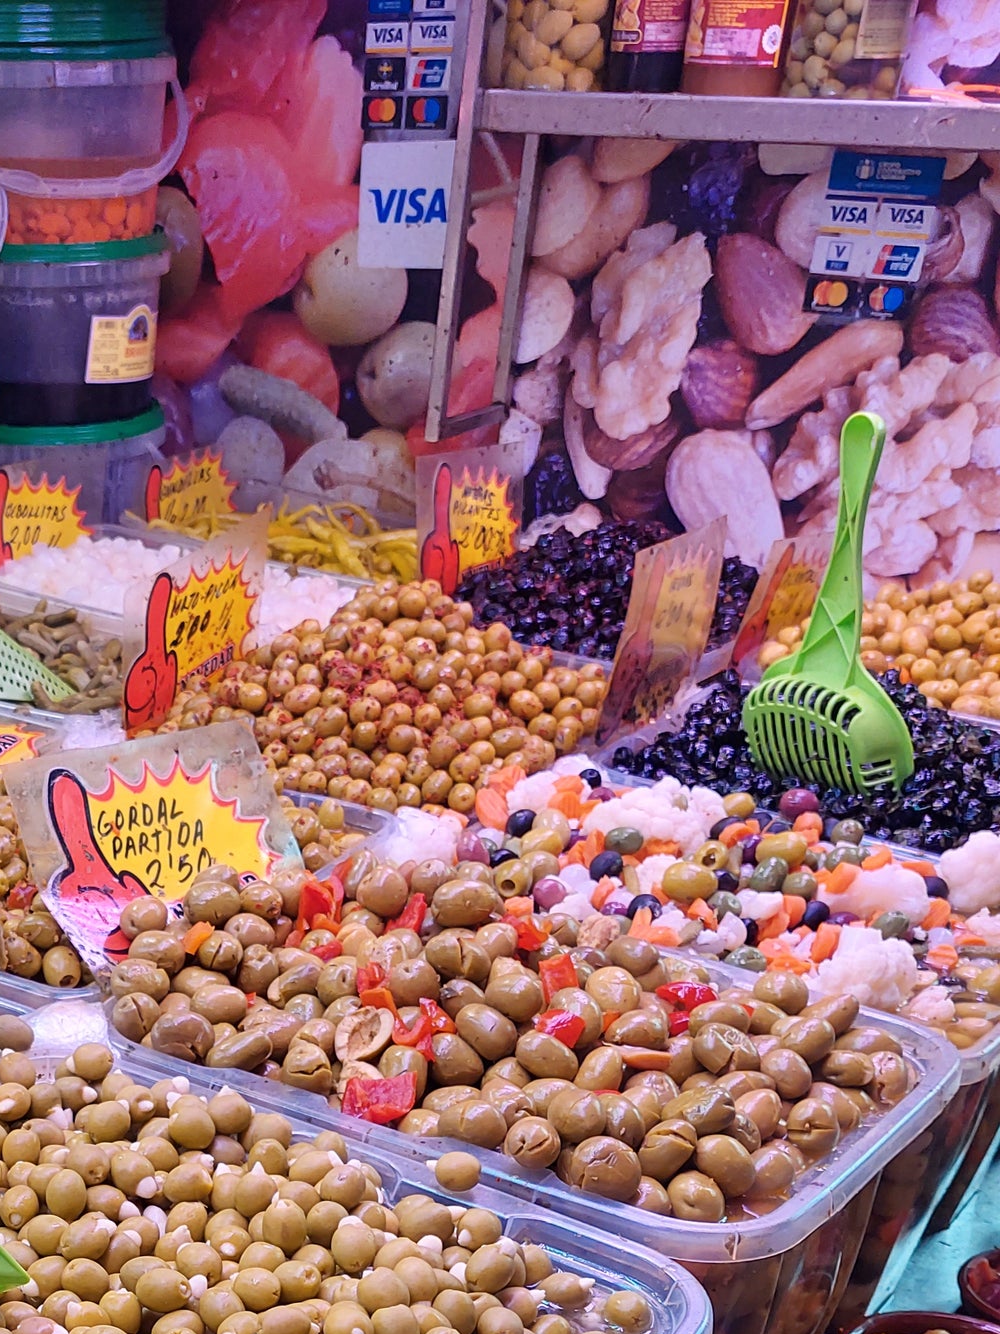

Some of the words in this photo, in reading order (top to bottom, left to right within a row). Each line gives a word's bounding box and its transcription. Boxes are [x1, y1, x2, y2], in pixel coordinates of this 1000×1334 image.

[373, 28, 403, 43] VISA
[420, 25, 448, 39] VISA
[368, 188, 447, 223] VISA
[831, 205, 868, 223] VISA
[890, 207, 925, 224] VISA
[5, 503, 67, 522] CEBOLLITAS
[97, 797, 184, 837] GORDAL
[112, 819, 203, 860] PARTIDA
